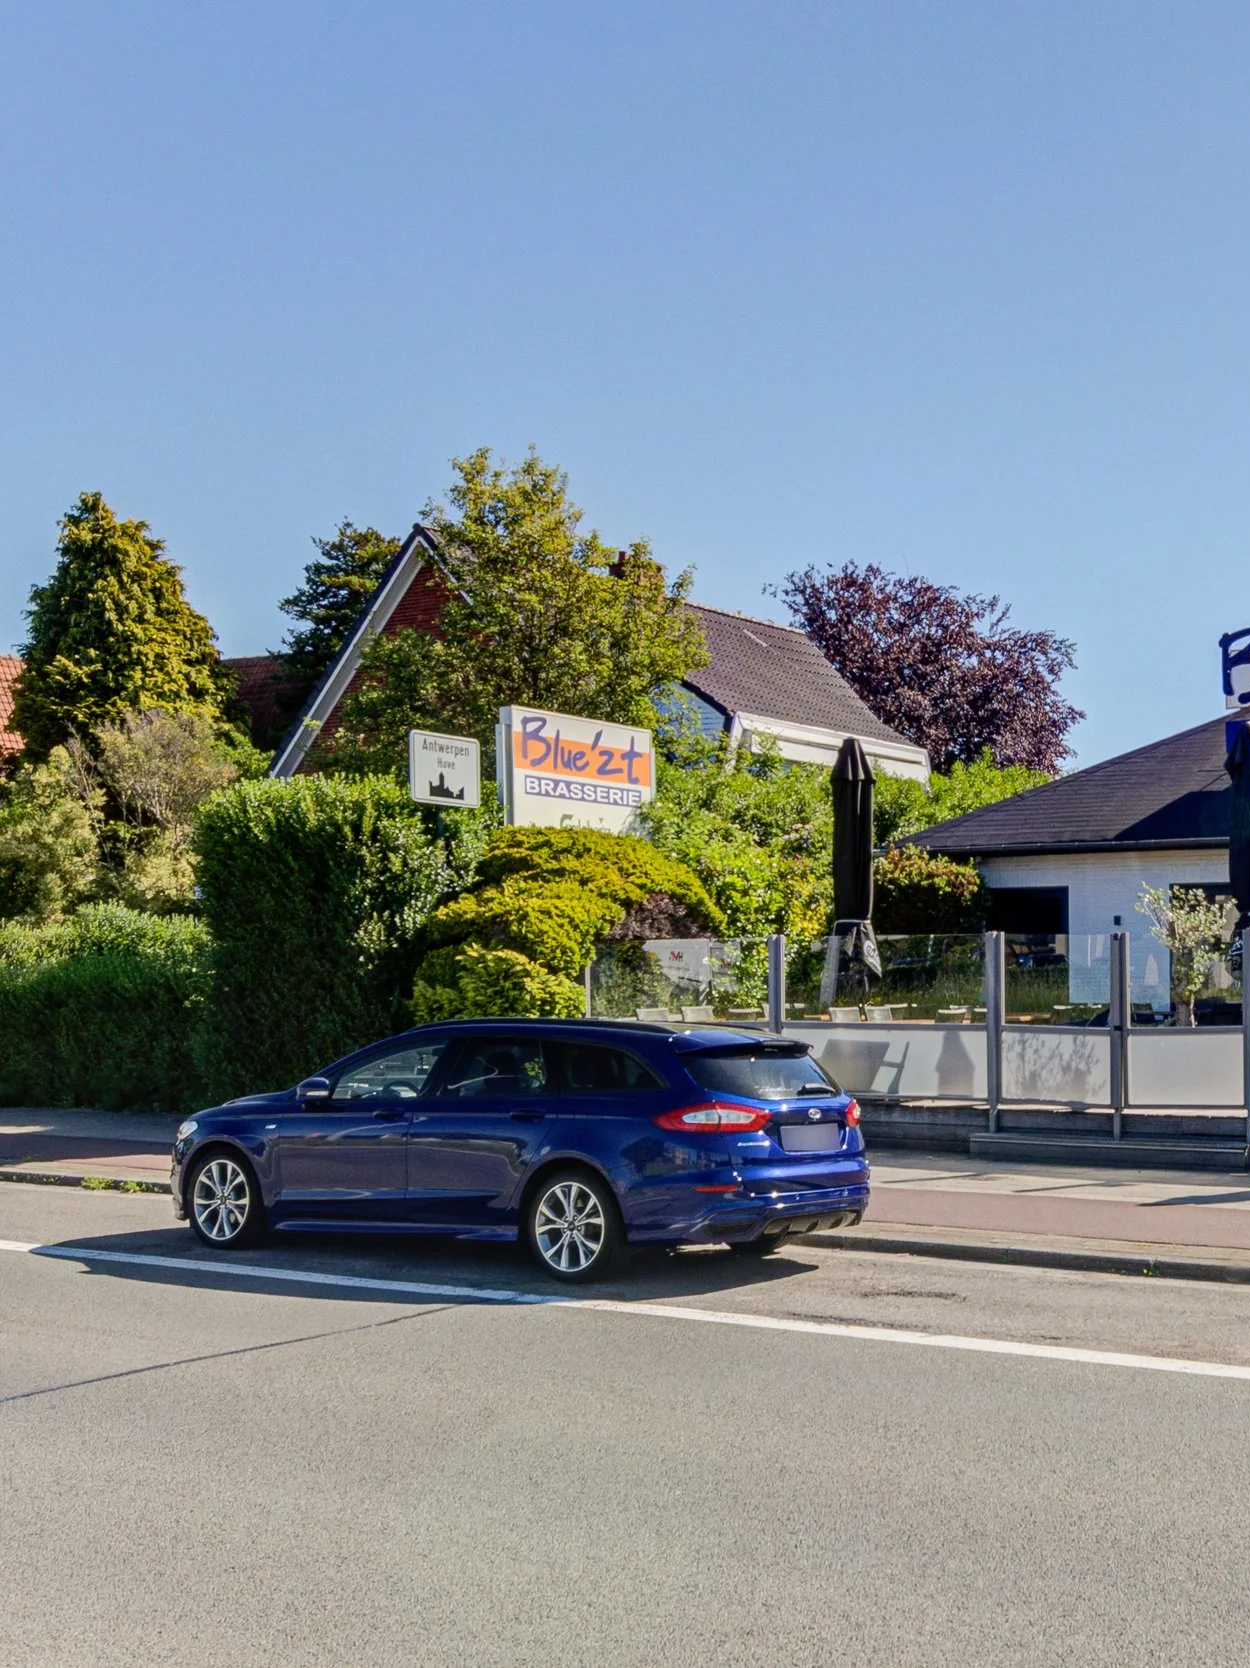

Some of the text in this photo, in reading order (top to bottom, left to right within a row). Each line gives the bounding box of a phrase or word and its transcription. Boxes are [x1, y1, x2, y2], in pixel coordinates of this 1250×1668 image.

[422, 737, 470, 758] Antwerpen
[520, 715, 643, 785] Blue'zt
[525, 776, 641, 806] BRASSERIE
